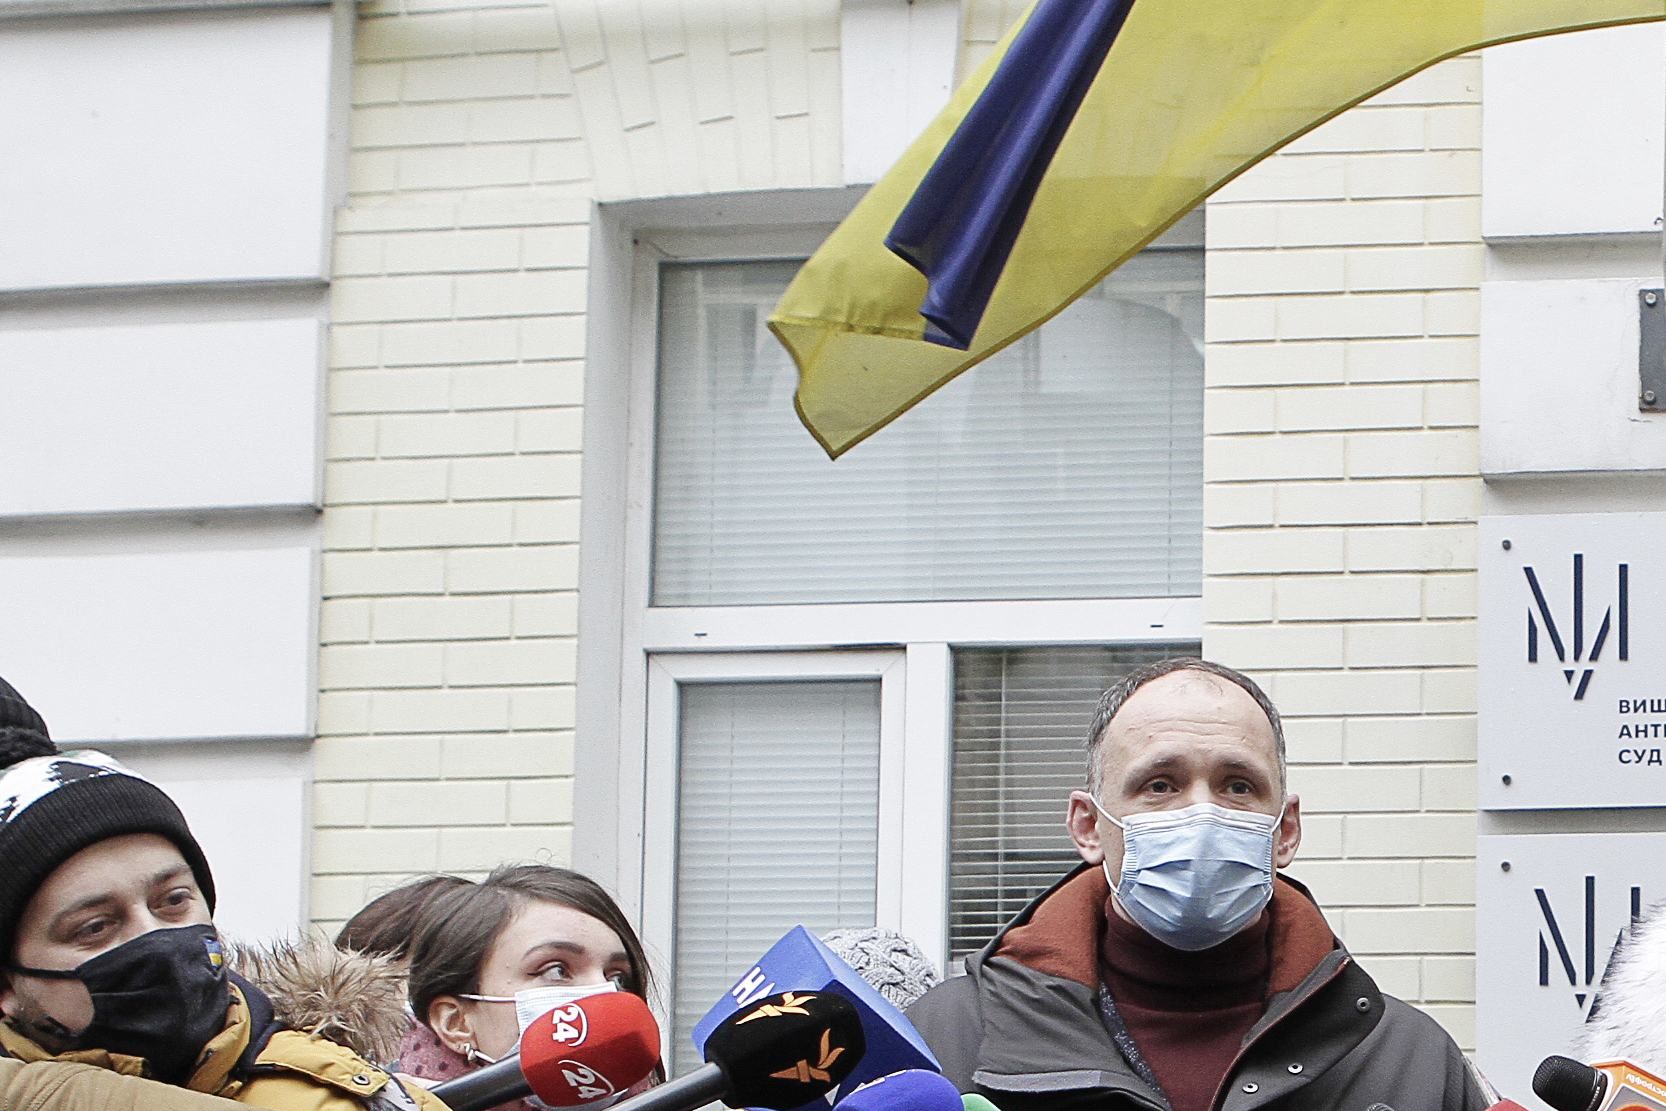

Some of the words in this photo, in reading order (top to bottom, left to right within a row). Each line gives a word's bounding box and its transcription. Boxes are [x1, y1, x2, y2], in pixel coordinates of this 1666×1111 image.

[1617, 748, 1663, 766] СУД
[552, 1005, 579, 1043] 24
[561, 1067, 608, 1099] 24
